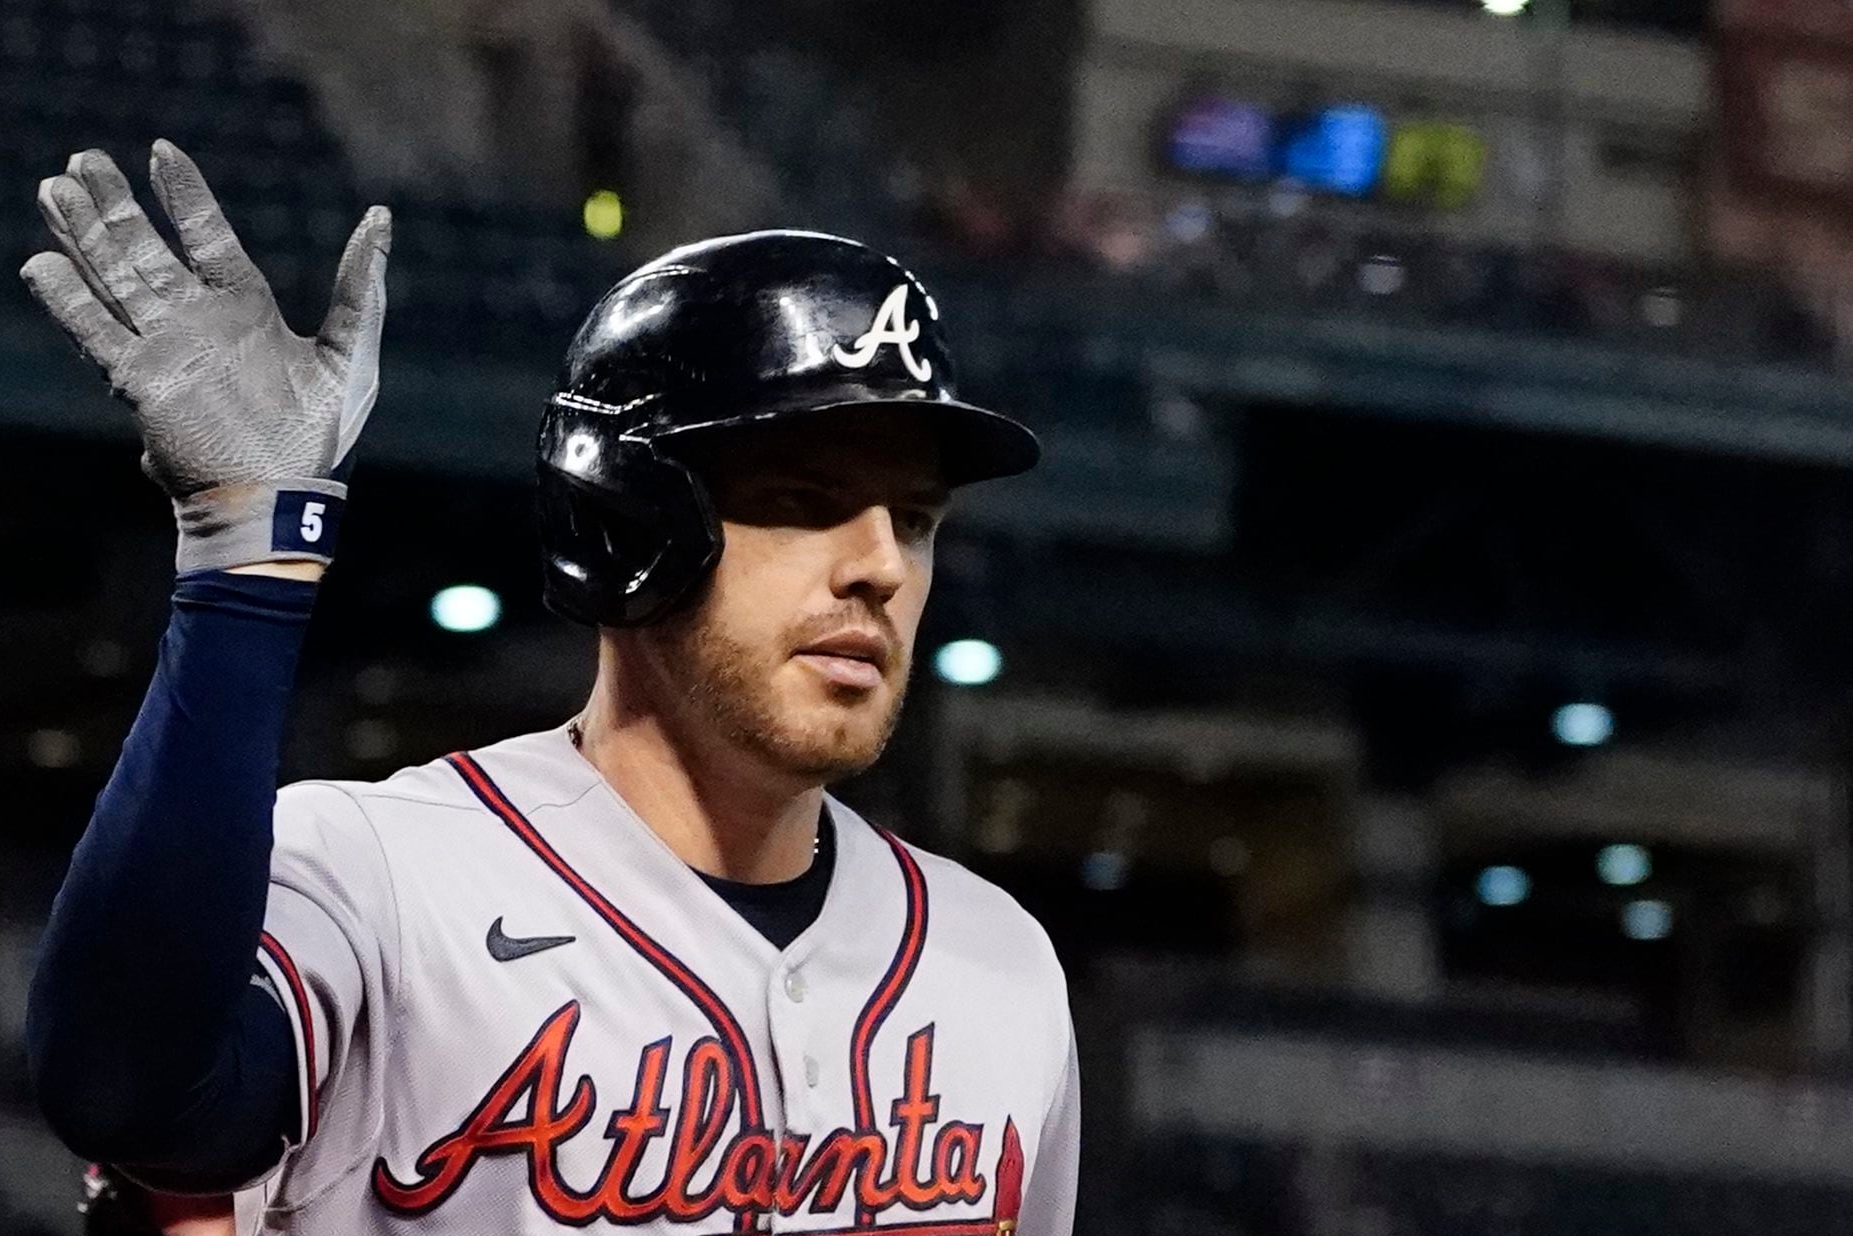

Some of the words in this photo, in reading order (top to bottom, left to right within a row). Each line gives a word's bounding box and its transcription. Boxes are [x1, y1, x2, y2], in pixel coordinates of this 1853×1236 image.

[833, 283, 932, 382] A
[300, 501, 326, 543] 5
[371, 999, 988, 1228] Atlanta
